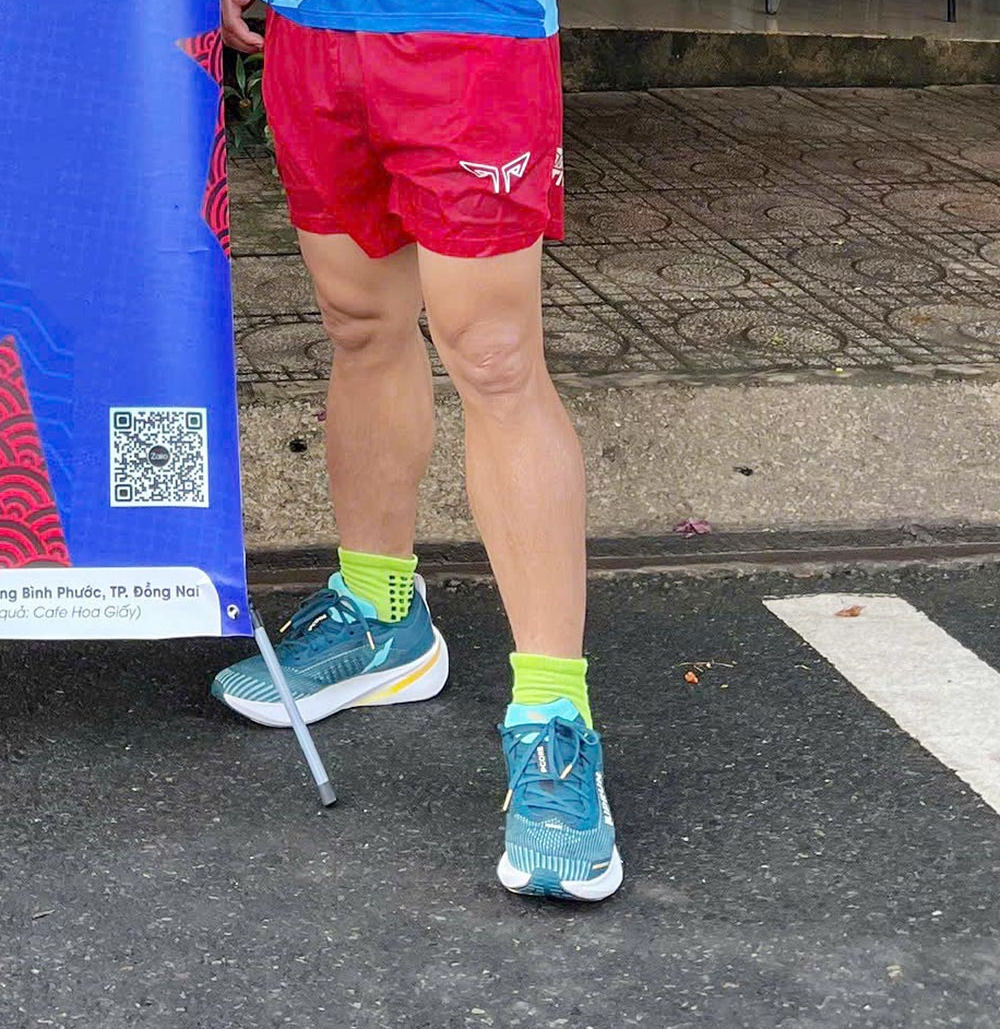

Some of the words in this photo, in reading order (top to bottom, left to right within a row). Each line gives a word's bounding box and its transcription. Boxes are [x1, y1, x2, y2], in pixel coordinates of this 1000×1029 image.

[22, 585, 53, 600] Bình
[57, 585, 106, 601] Phước,
[110, 585, 128, 598] TP.
[133, 582, 171, 601] Đồng
[175, 584, 200, 598] Nai
[33, 604, 68, 619] Cafe
[71, 605, 100, 619] Hoa
[104, 603, 142, 621] Giấy)
